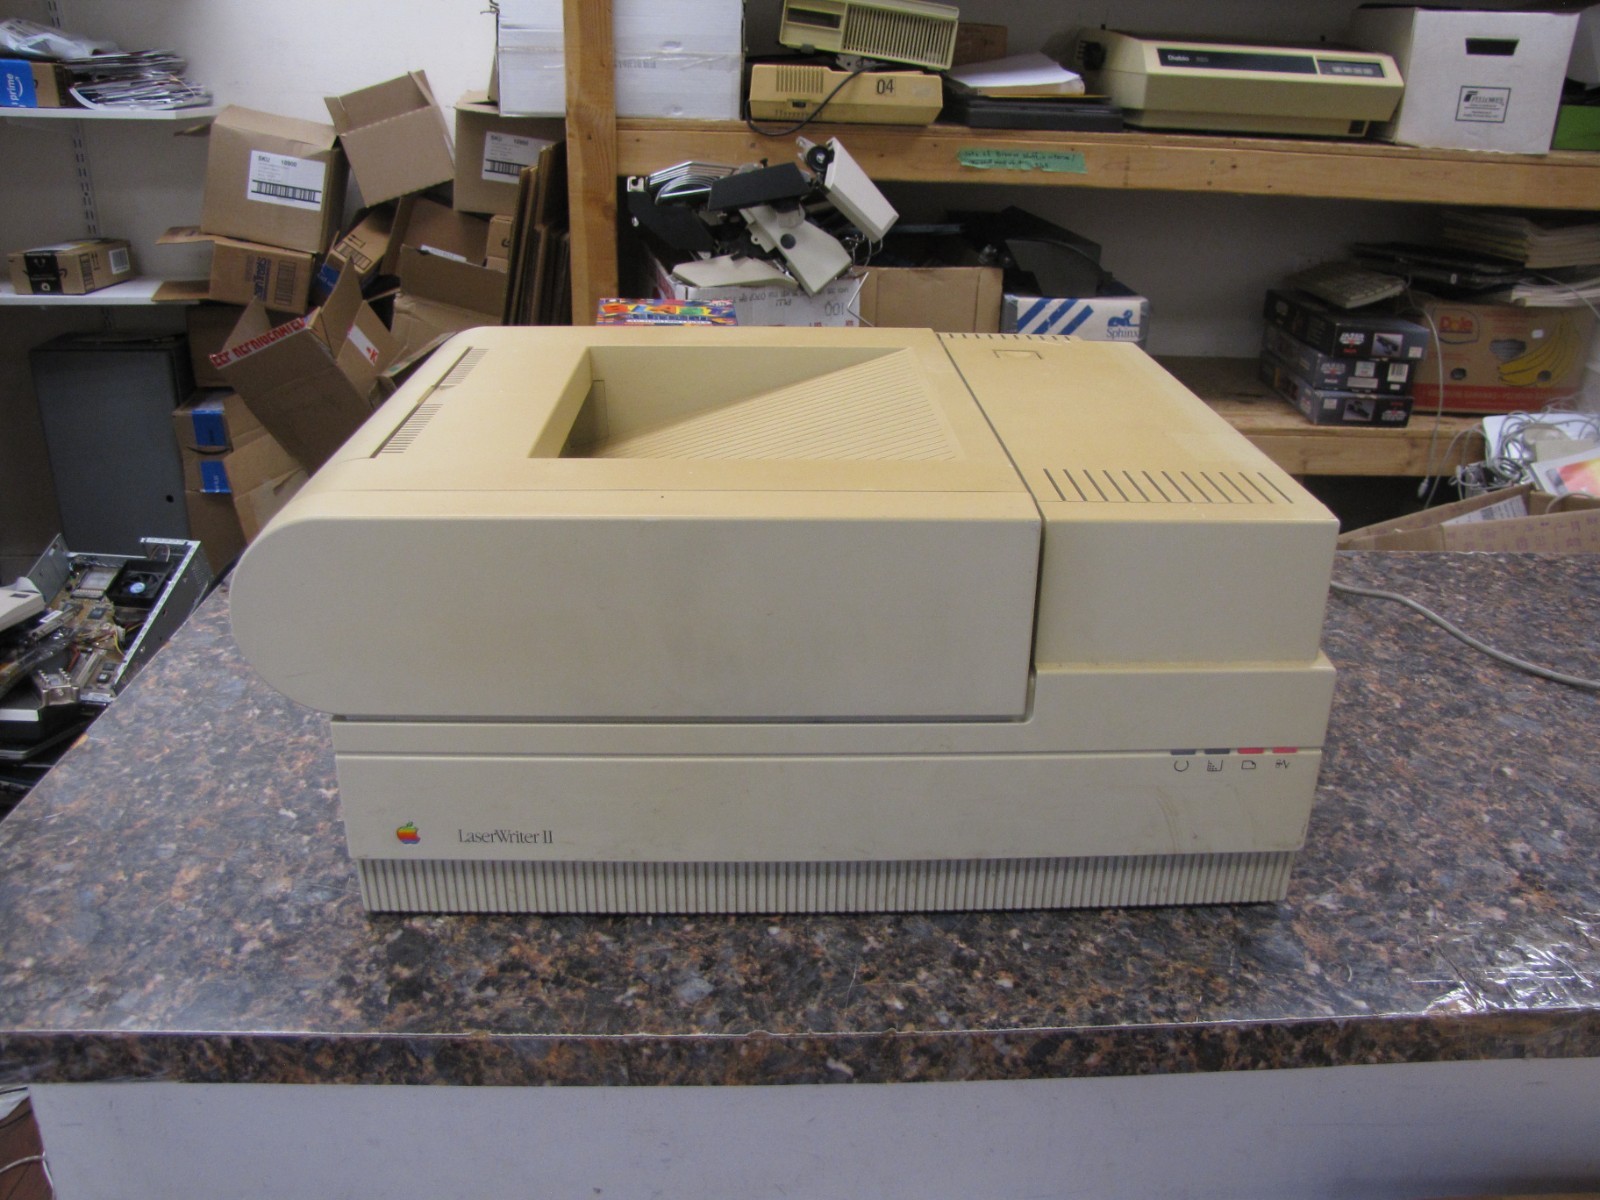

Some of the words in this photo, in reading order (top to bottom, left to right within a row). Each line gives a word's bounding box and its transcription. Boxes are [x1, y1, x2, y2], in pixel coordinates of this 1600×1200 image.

[6, 73, 20, 101] prime
[876, 78, 894, 95] 04
[257, 155, 271, 163] SKU
[1439, 315, 1474, 331] Dole
[1106, 327, 1140, 340] Sphinx
[458, 828, 540, 844] LaserWriter
[543, 829, 553, 844] II
